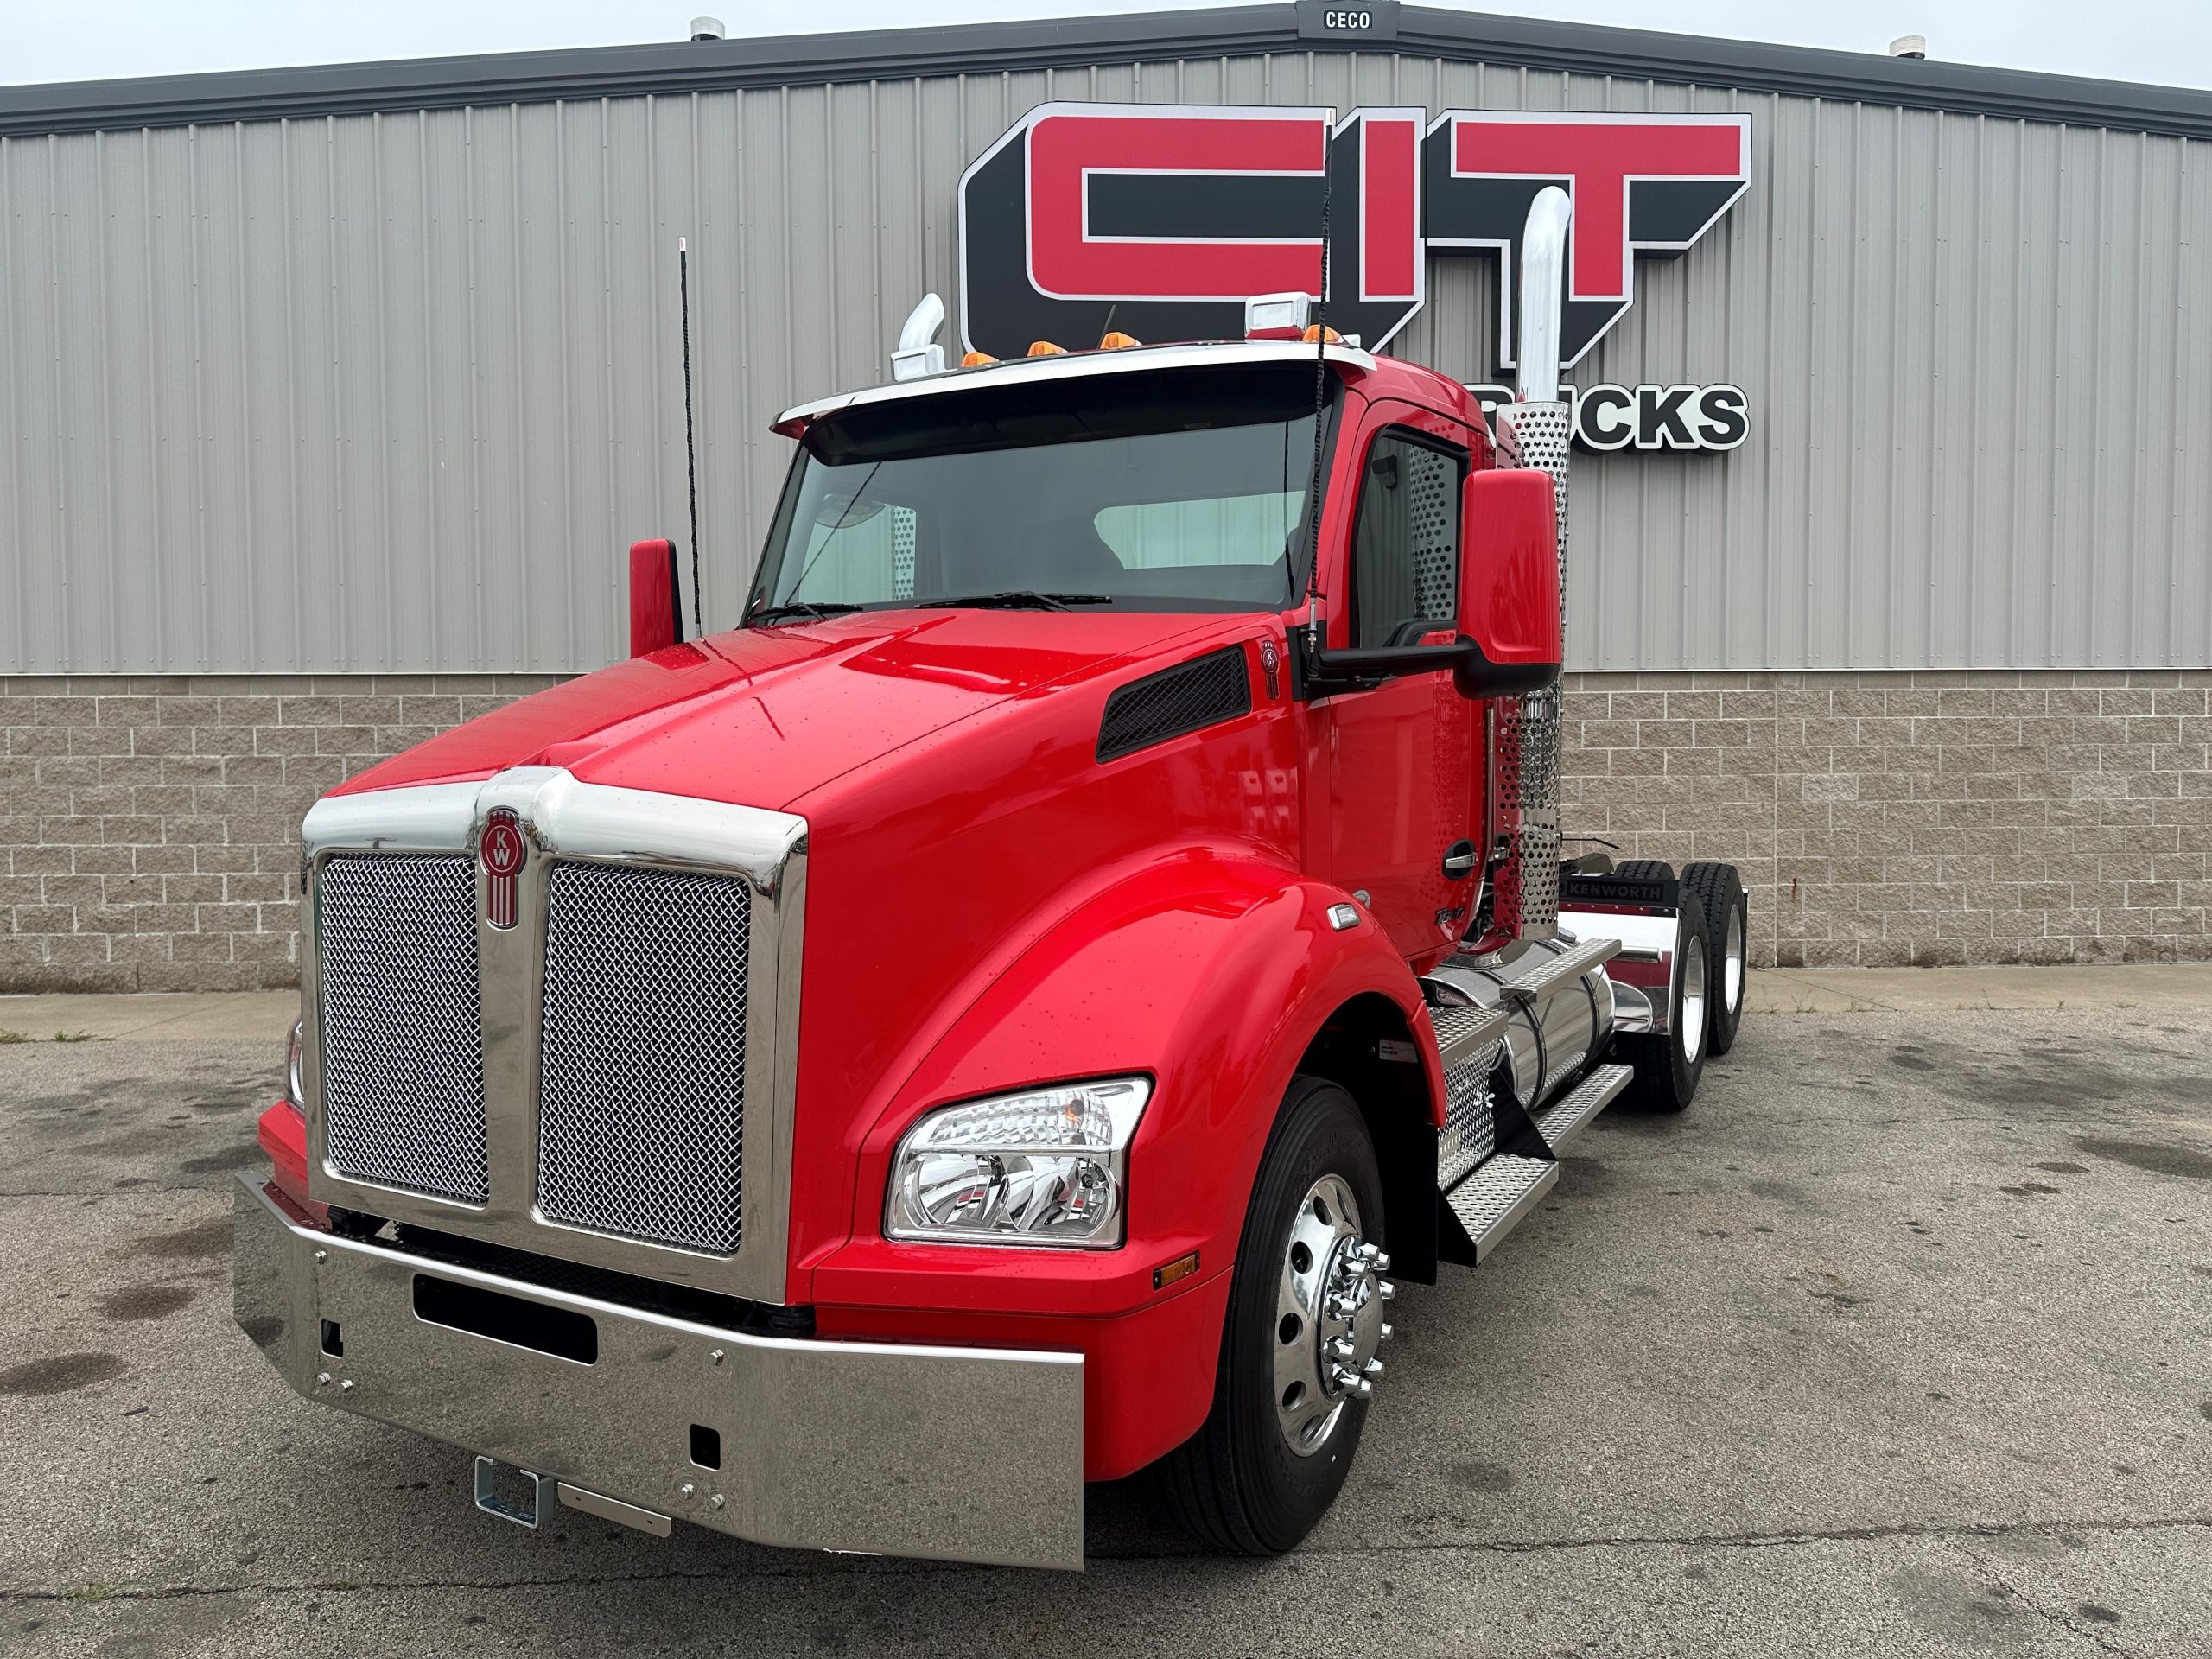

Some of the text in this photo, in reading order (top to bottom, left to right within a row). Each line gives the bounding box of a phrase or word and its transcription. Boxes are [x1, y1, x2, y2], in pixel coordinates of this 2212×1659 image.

[1325, 10, 1370, 29] CECO
[1025, 102, 1752, 304] CIT
[1465, 385, 1748, 449] RCKS
[1569, 882, 1662, 899] KENWORTH
